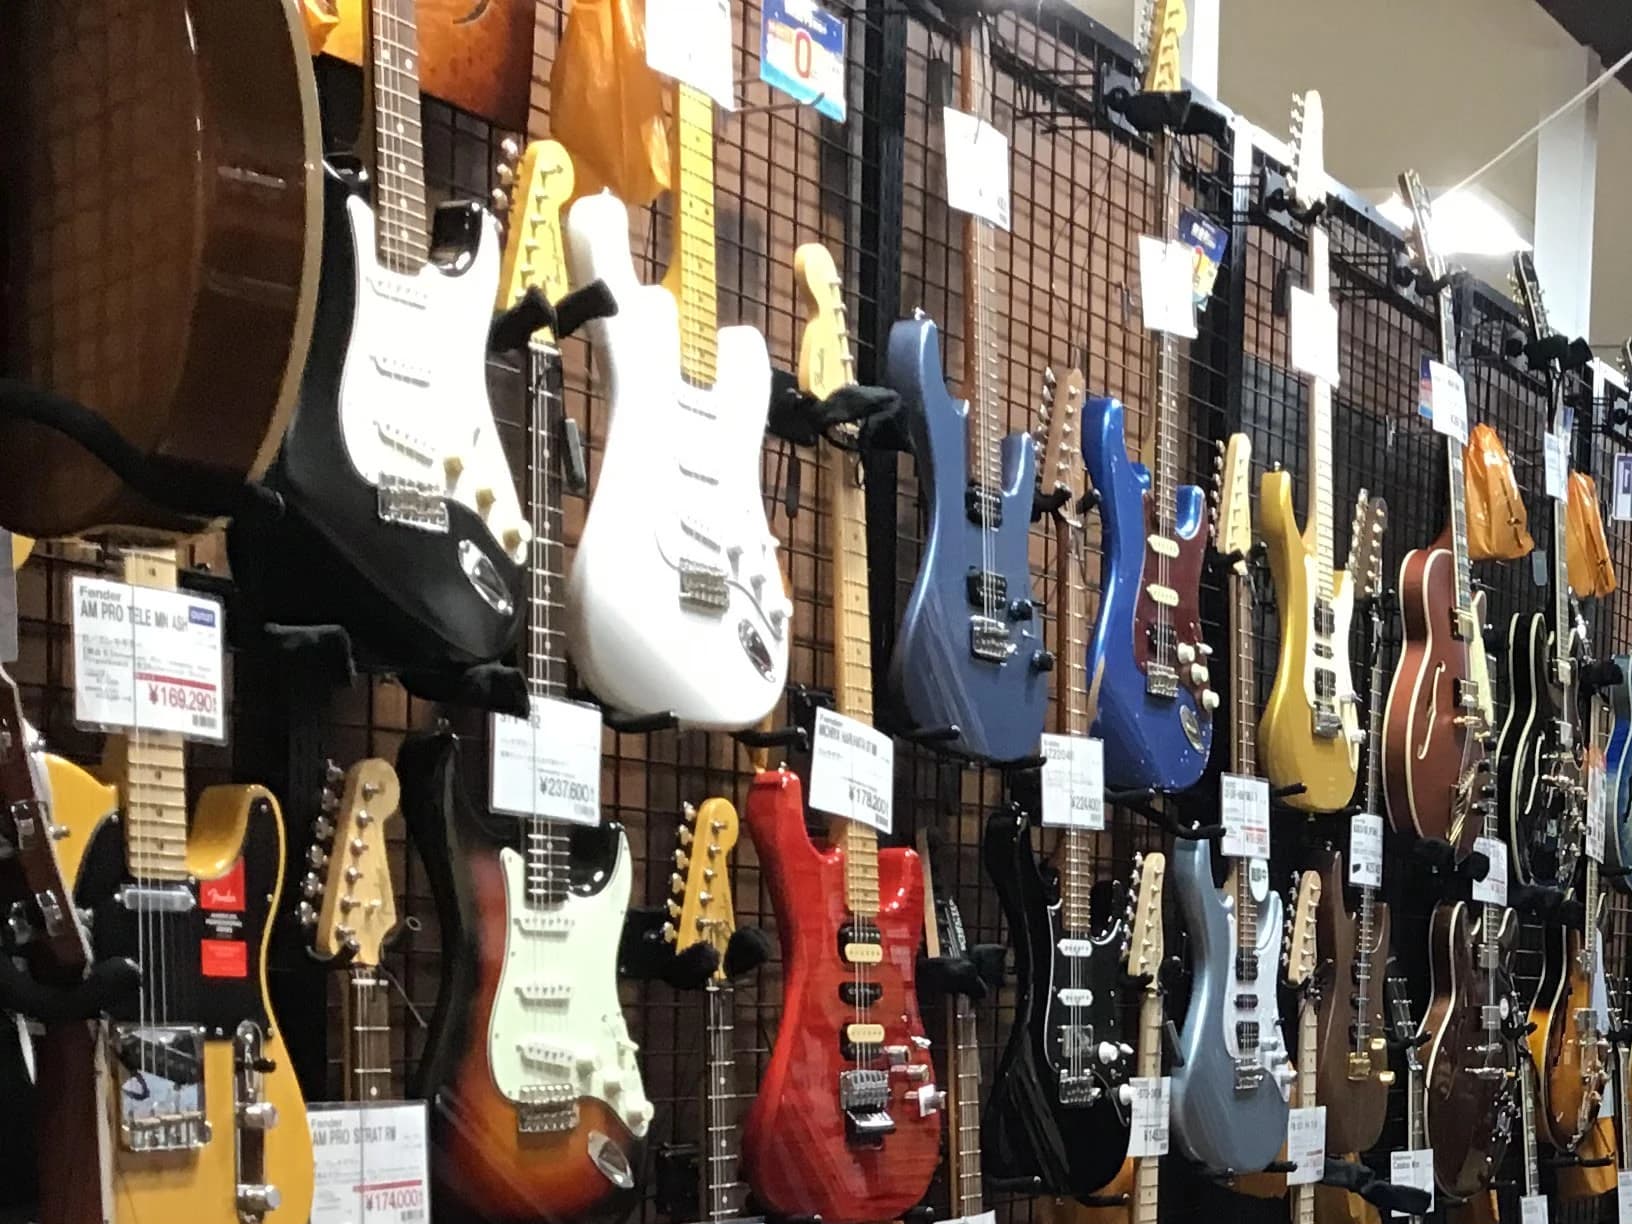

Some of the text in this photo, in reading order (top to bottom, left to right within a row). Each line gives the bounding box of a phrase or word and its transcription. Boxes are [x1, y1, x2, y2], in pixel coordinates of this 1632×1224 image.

[79, 585, 122, 601] Fender
[80, 600, 98, 618] AM
[101, 603, 124, 622] PRO
[127, 606, 152, 626] TELE
